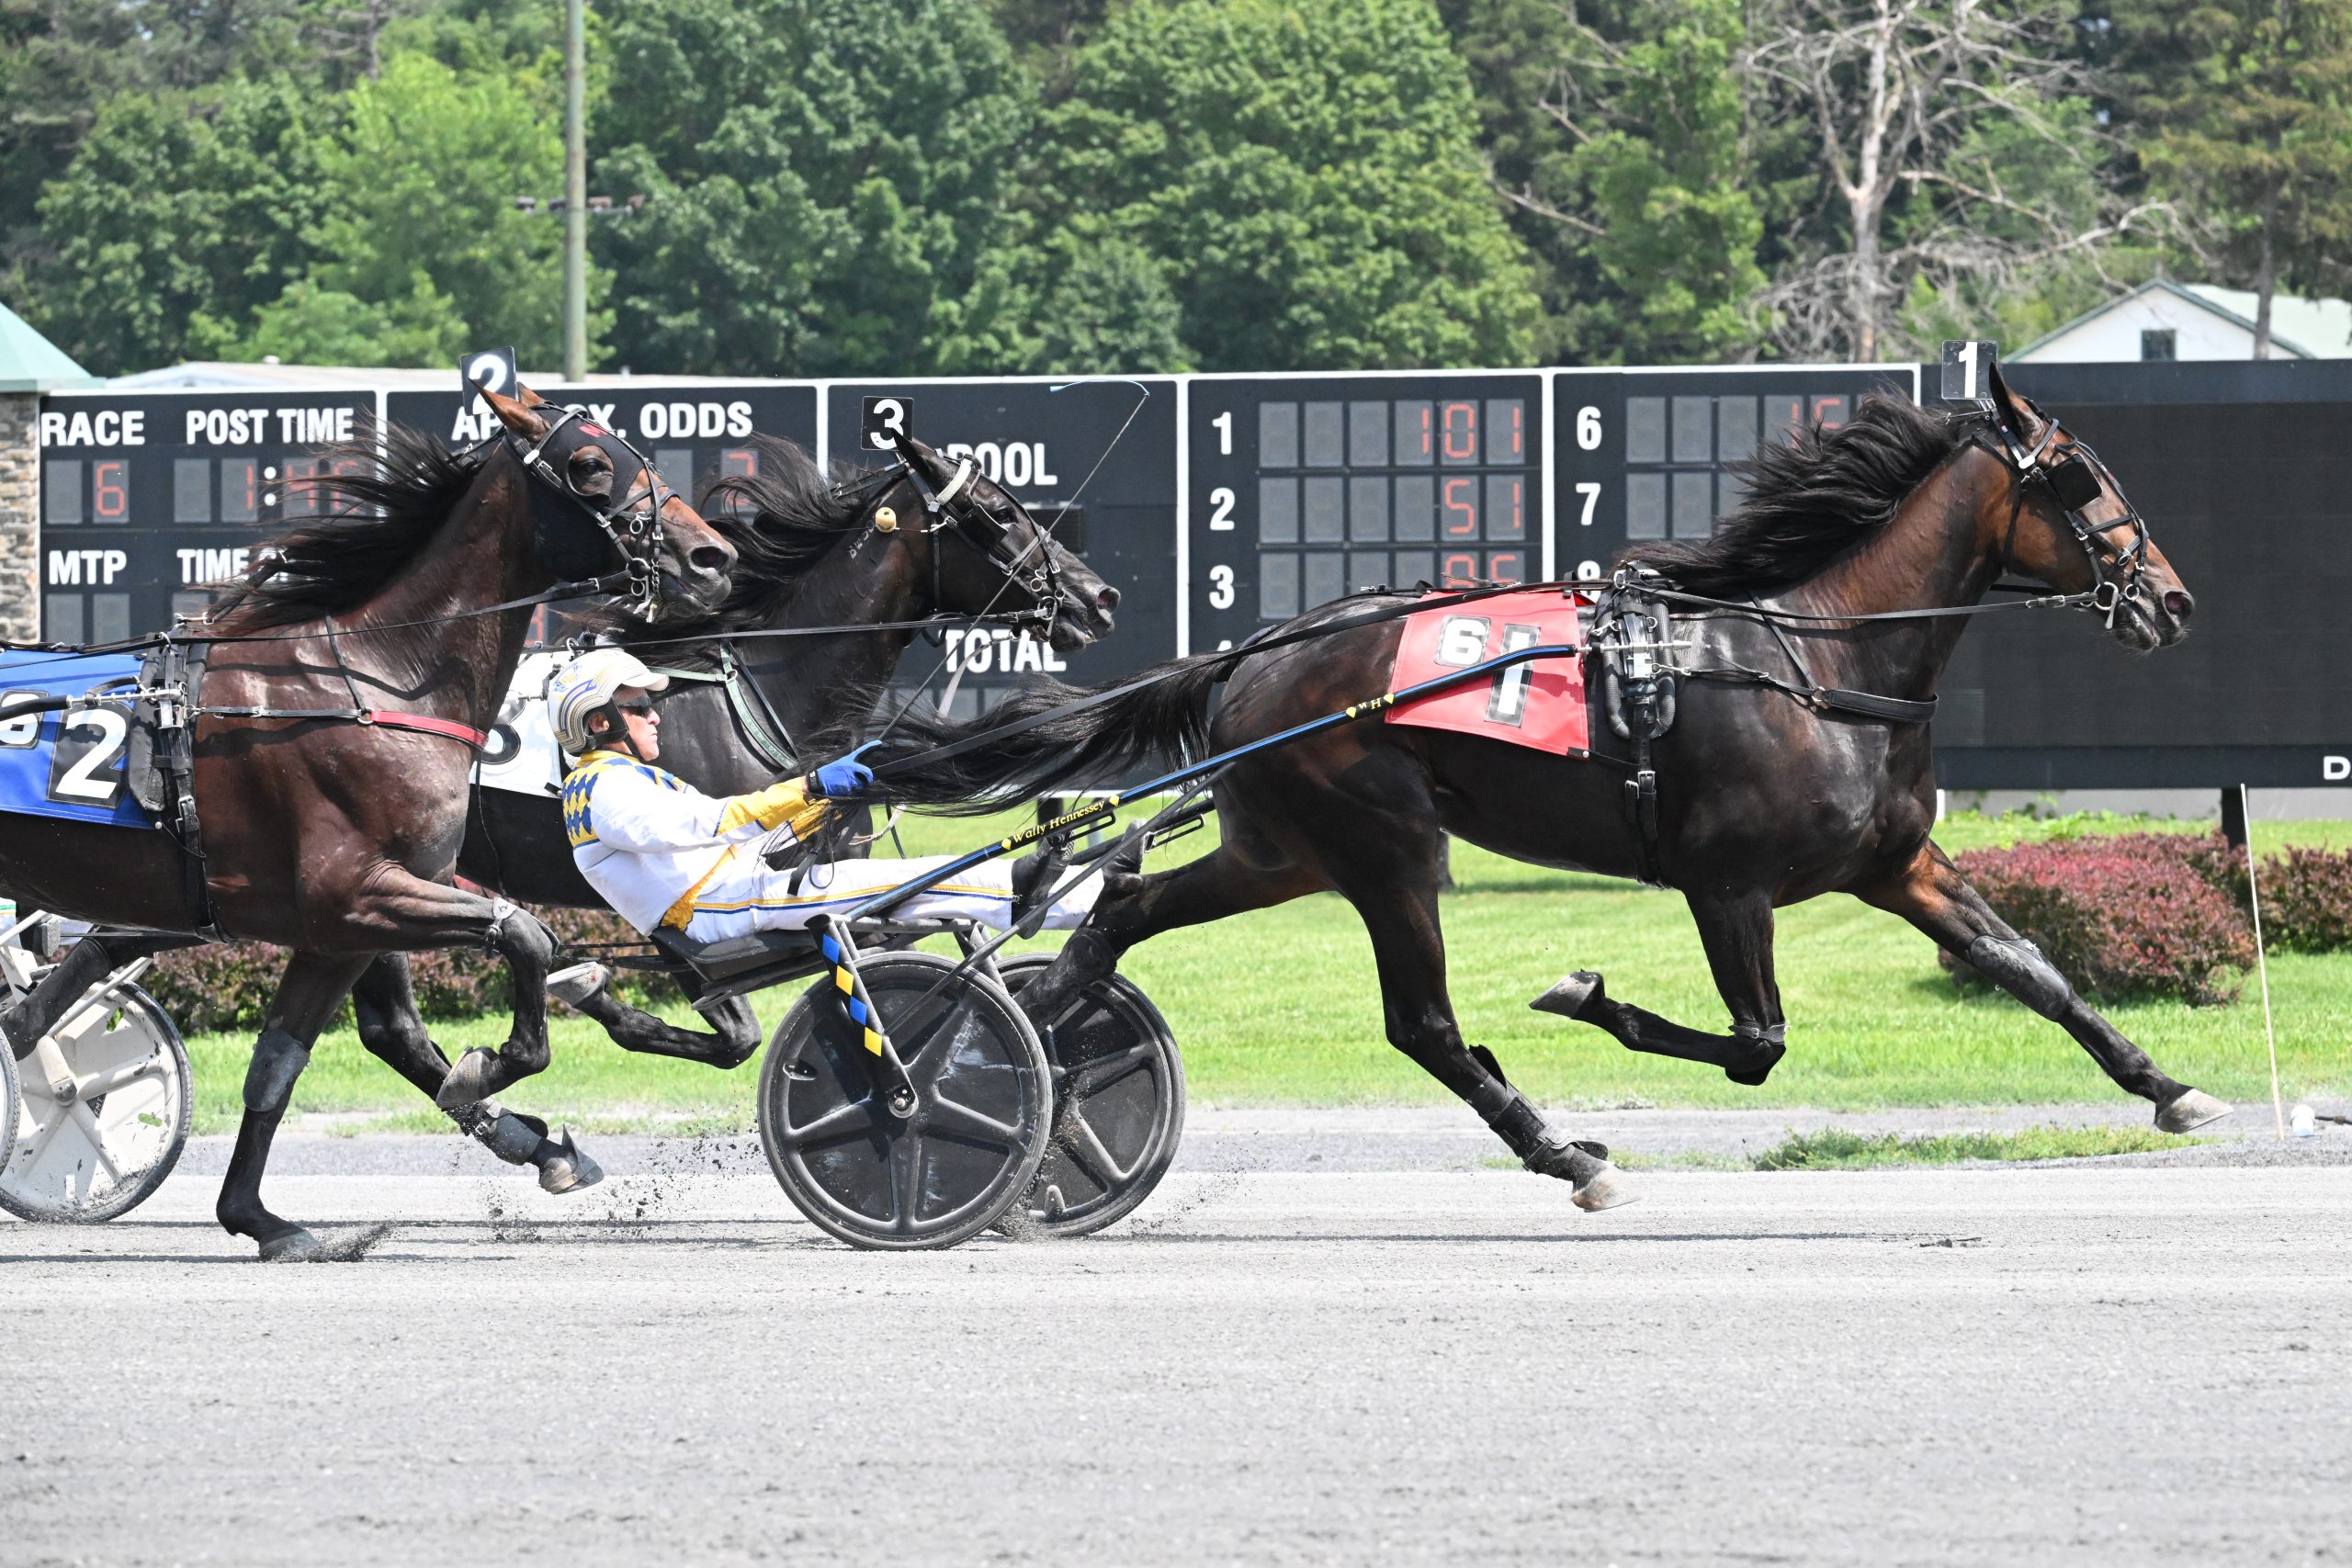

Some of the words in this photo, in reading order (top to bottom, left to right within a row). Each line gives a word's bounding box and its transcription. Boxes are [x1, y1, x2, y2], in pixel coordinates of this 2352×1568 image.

[468, 354, 507, 415] 2
[1958, 341, 1978, 400] 1
[40, 410, 145, 446] RACE
[187, 409, 269, 445] POST
[276, 407, 355, 444] TIME
[639, 400, 753, 439] ODDS
[870, 399, 904, 450] 3
[1212, 412, 1232, 455] 1
[1422, 403, 1521, 458] 101
[1577, 406, 1602, 450] 6
[96, 461, 127, 517] 6
[1209, 487, 1236, 531] 2
[1443, 479, 1521, 535] 51
[1576, 482, 1601, 525] 7
[49, 549, 127, 585] MTP
[176, 547, 250, 585] TIME
[1209, 564, 1235, 610] 3
[938, 627, 1068, 673] TOTAL
[1440, 617, 1488, 666] 6
[1497, 631, 1531, 716] 1
[55, 708, 127, 799] 2
[1012, 823, 1046, 843] Wally
[1049, 800, 1105, 829] Hennessey
